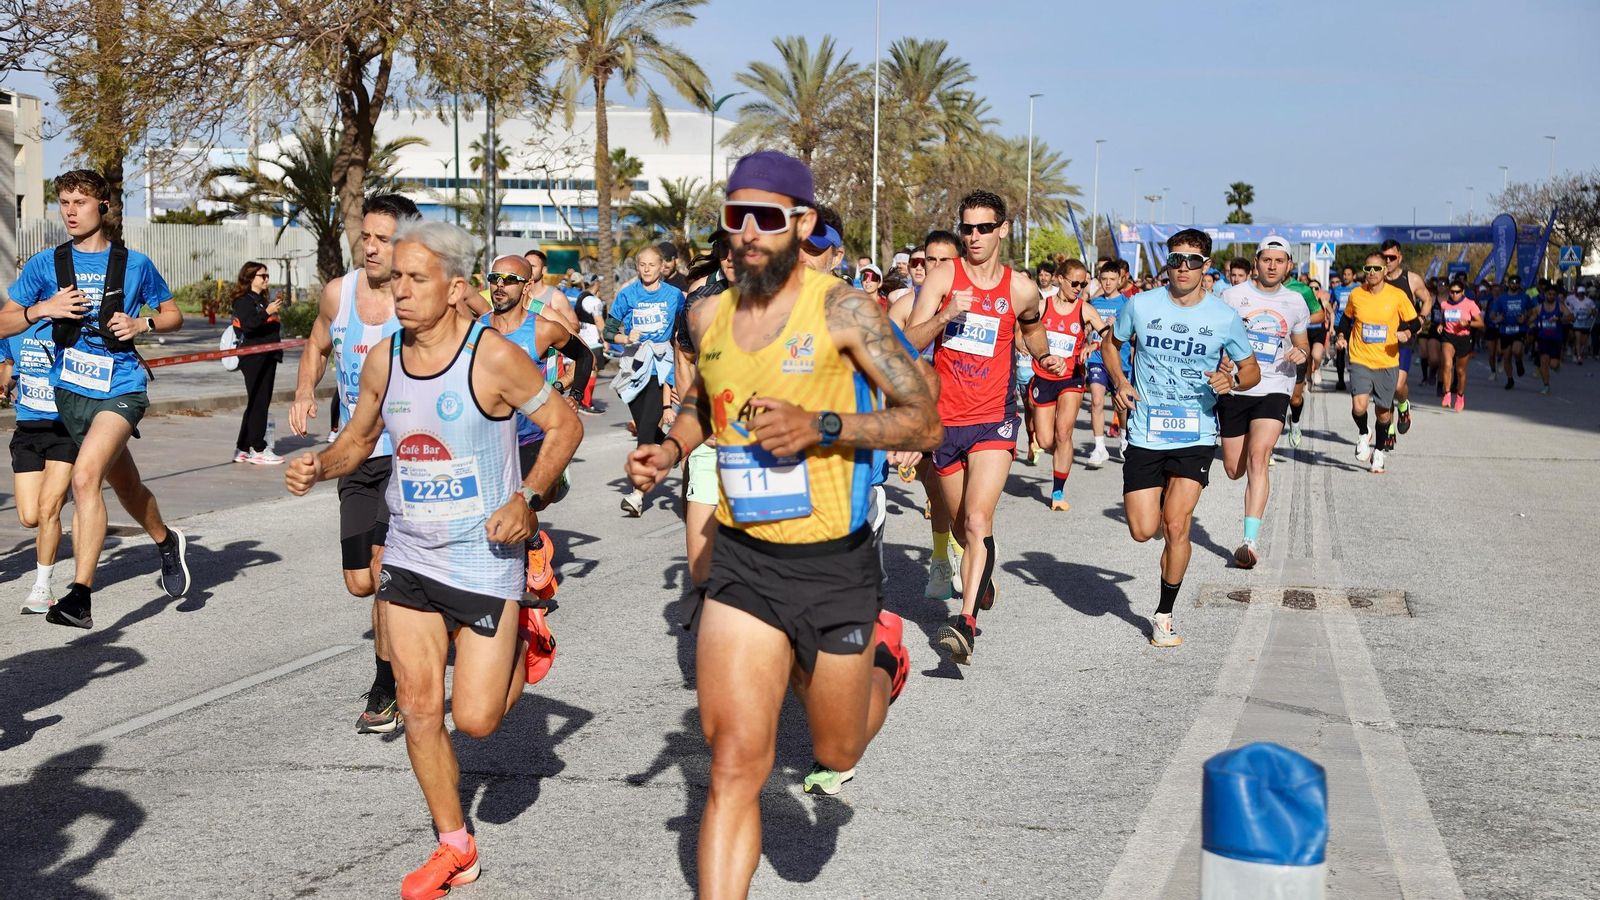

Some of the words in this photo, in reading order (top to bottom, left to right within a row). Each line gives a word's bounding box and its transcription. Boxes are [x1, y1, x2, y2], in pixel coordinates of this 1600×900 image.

[1301, 228, 1343, 240] mayoral
[955, 325, 986, 340] 1540
[1145, 335, 1207, 356] nerja
[71, 361, 101, 378] 1024
[26, 386, 54, 400] 2606
[1162, 418, 1186, 430] 608
[400, 444, 420, 454] Café
[423, 444, 441, 454] Bar
[743, 469, 768, 491] 11
[412, 480, 464, 499] 2226
